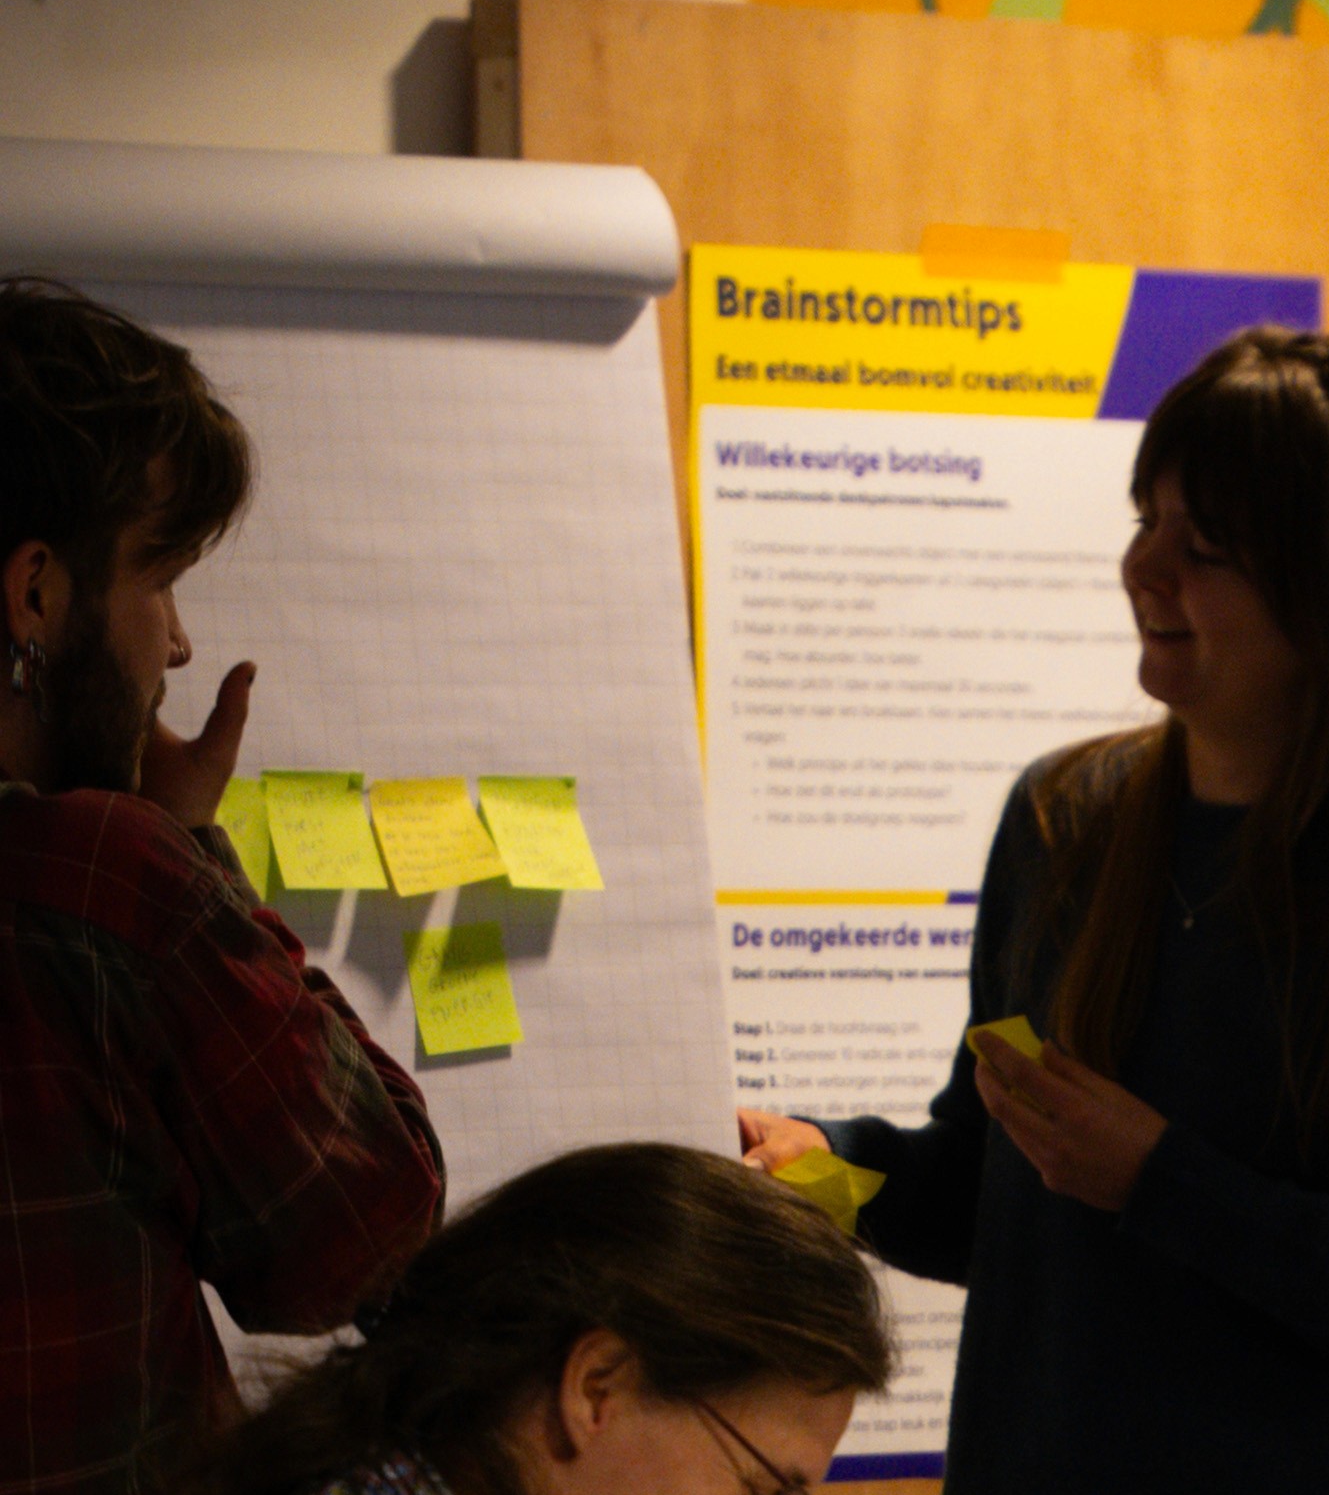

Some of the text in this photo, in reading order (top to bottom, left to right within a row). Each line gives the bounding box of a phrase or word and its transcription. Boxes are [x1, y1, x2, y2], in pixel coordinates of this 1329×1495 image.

[716, 276, 1023, 339] Brainstormtips
[715, 354, 758, 381] Een
[765, 358, 852, 385] etmaal
[858, 361, 956, 388] bomvol
[716, 441, 983, 482] Willekeurige botsing
[732, 921, 972, 953] De omgekeerde wer
